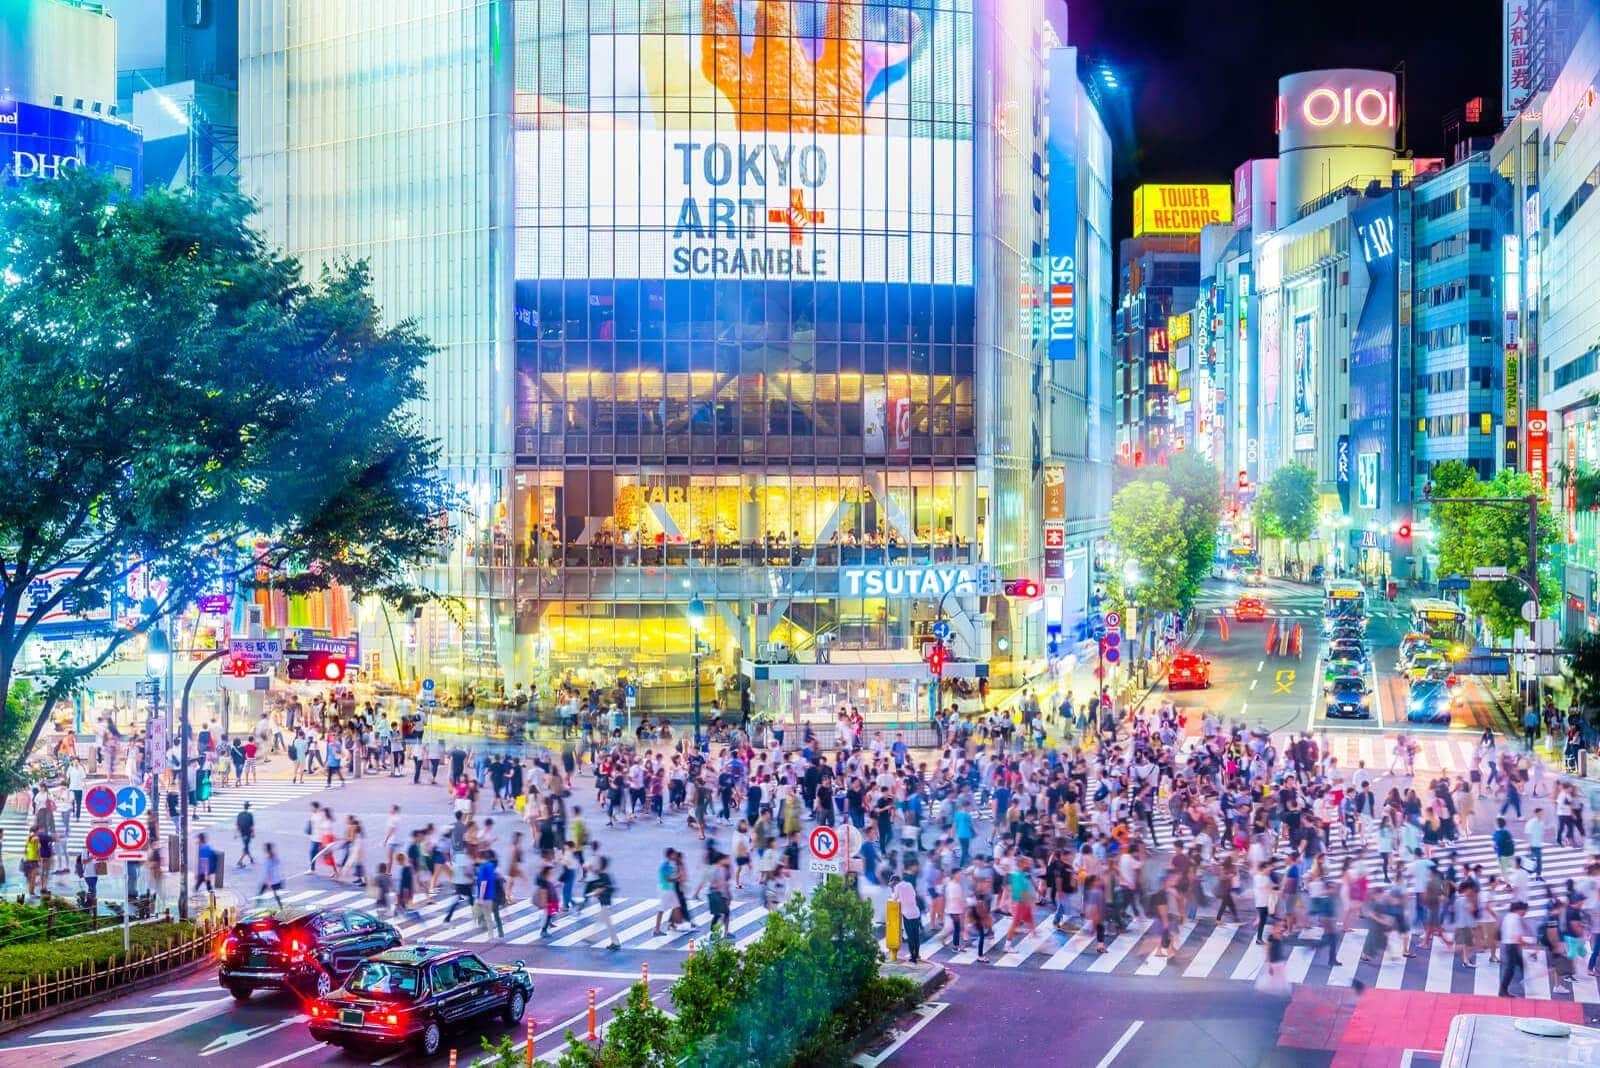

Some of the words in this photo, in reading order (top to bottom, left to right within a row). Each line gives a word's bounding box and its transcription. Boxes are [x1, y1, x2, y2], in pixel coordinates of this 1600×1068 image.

[1511, 5, 1529, 89] 大和証券
[673, 142, 827, 188] TOKYO
[1159, 188, 1210, 207] TOWER
[673, 197, 766, 239] ART
[1153, 209, 1220, 229] RECORDS
[673, 246, 827, 275] SCRAMBLE
[1051, 255, 1074, 340] SEIBU
[1339, 442, 1349, 482] ZARA
[1362, 530, 1377, 546] ZARA
[846, 569, 973, 595] TSUTAYA
[233, 641, 278, 652] 渋谷駅前
